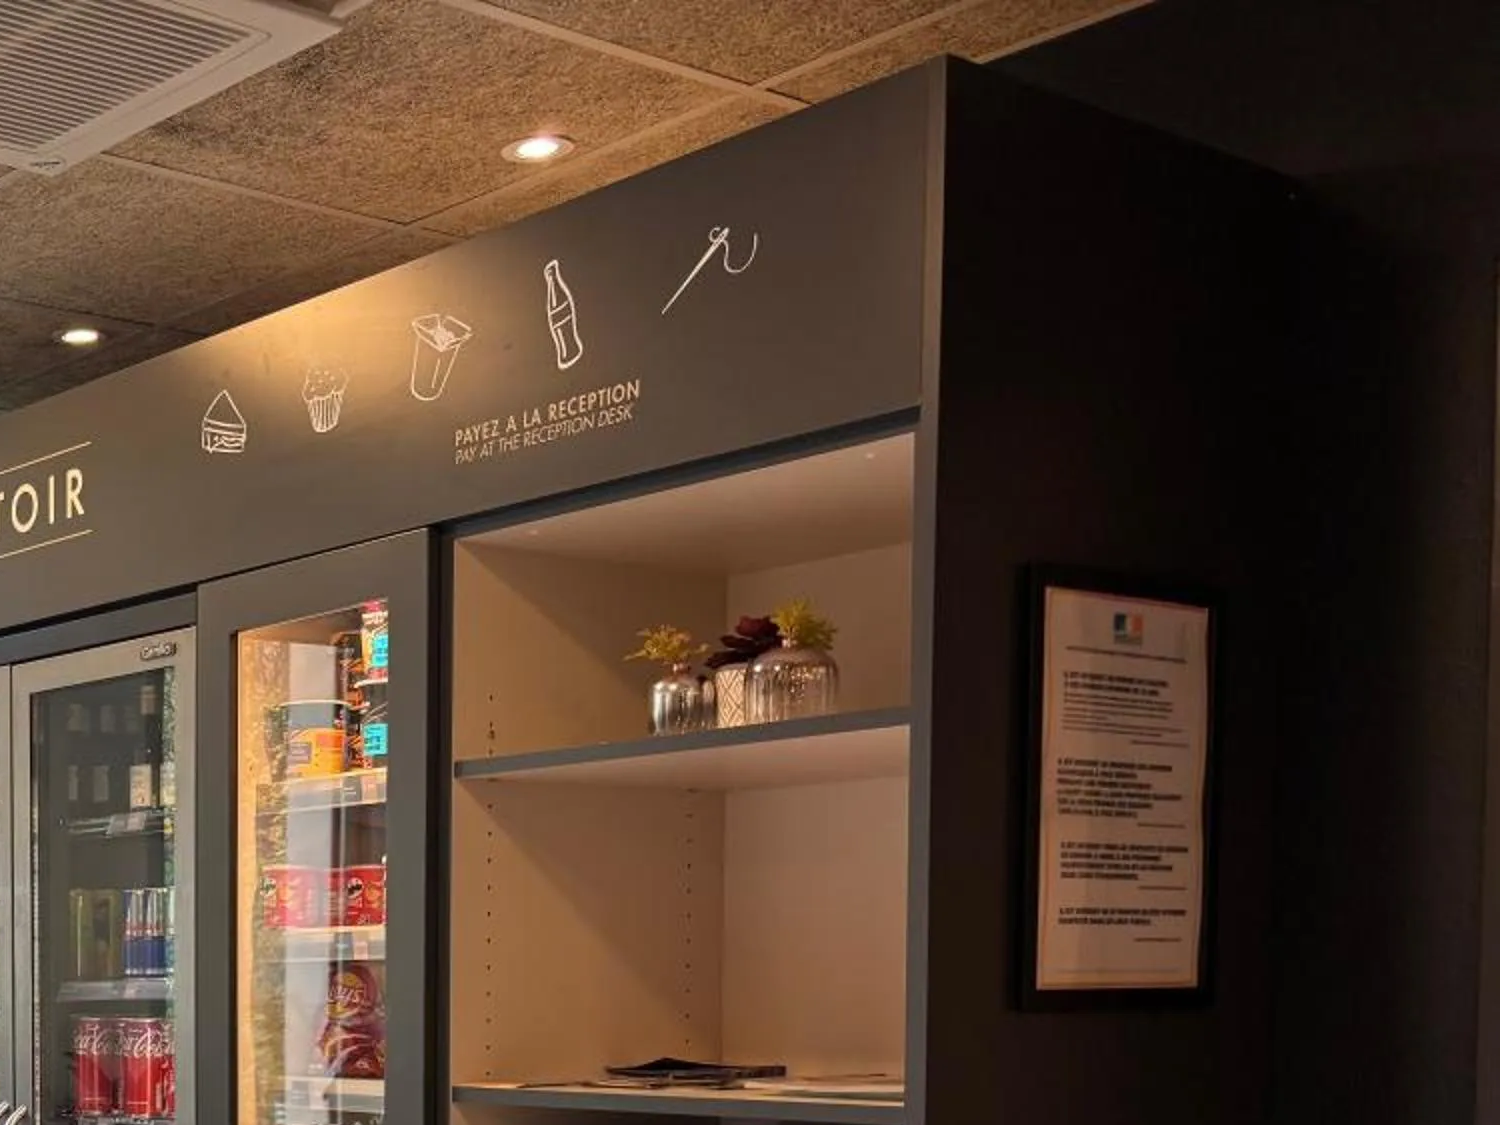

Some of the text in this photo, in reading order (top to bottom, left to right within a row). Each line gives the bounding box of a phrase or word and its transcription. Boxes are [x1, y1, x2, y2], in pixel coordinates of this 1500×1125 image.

[454, 379, 641, 447] PAYEZ A LA RECEPTION
[455, 403, 634, 465] PAY AT THE RECEPTION DESK
